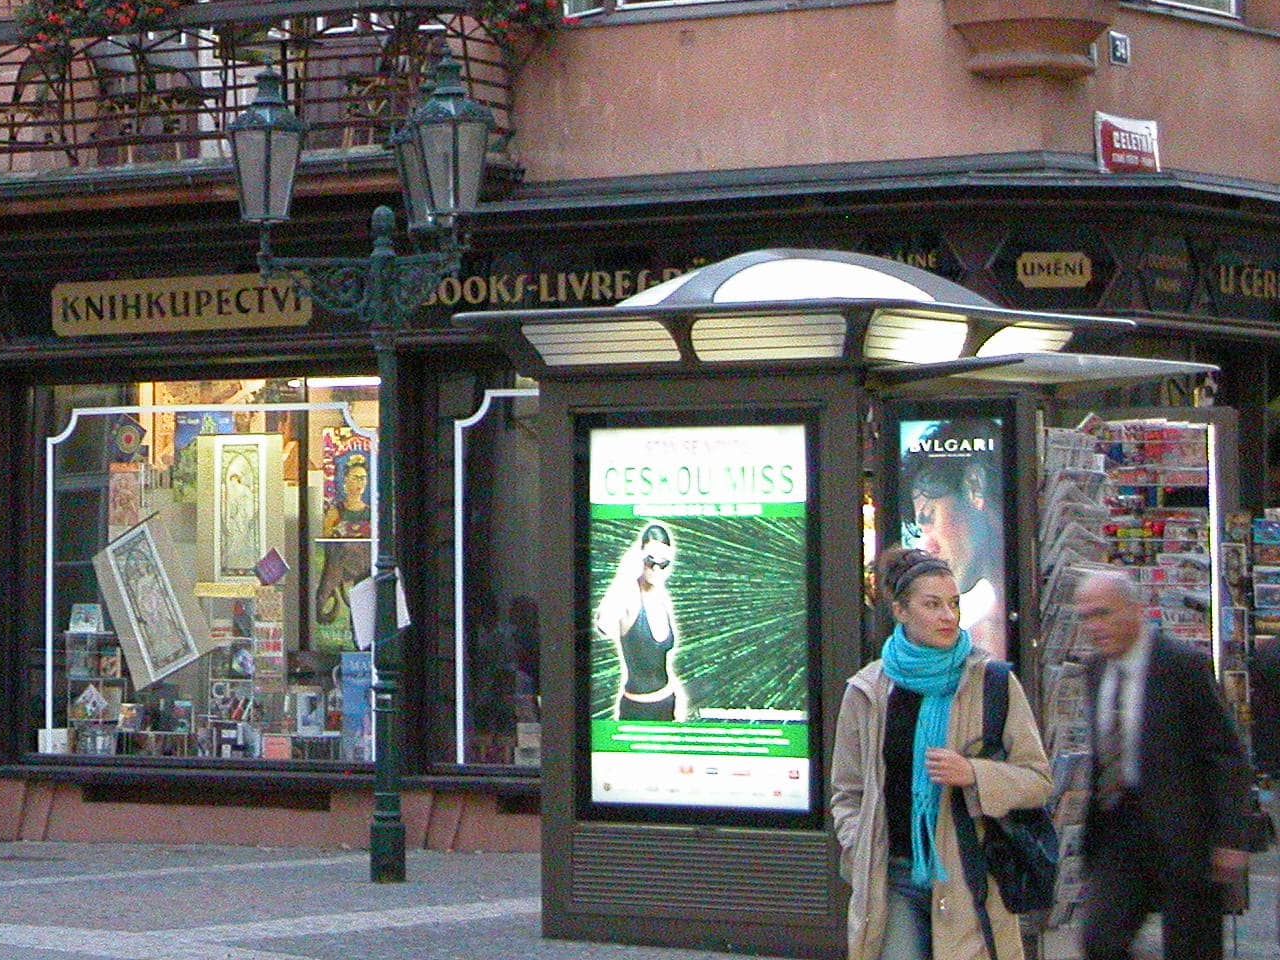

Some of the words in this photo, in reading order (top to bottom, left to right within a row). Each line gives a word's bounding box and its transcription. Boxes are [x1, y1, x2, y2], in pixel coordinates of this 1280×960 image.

[1221, 265, 1235, 294] U
[909, 438, 994, 452] BVLGARI
[724, 464, 795, 495] MISS
